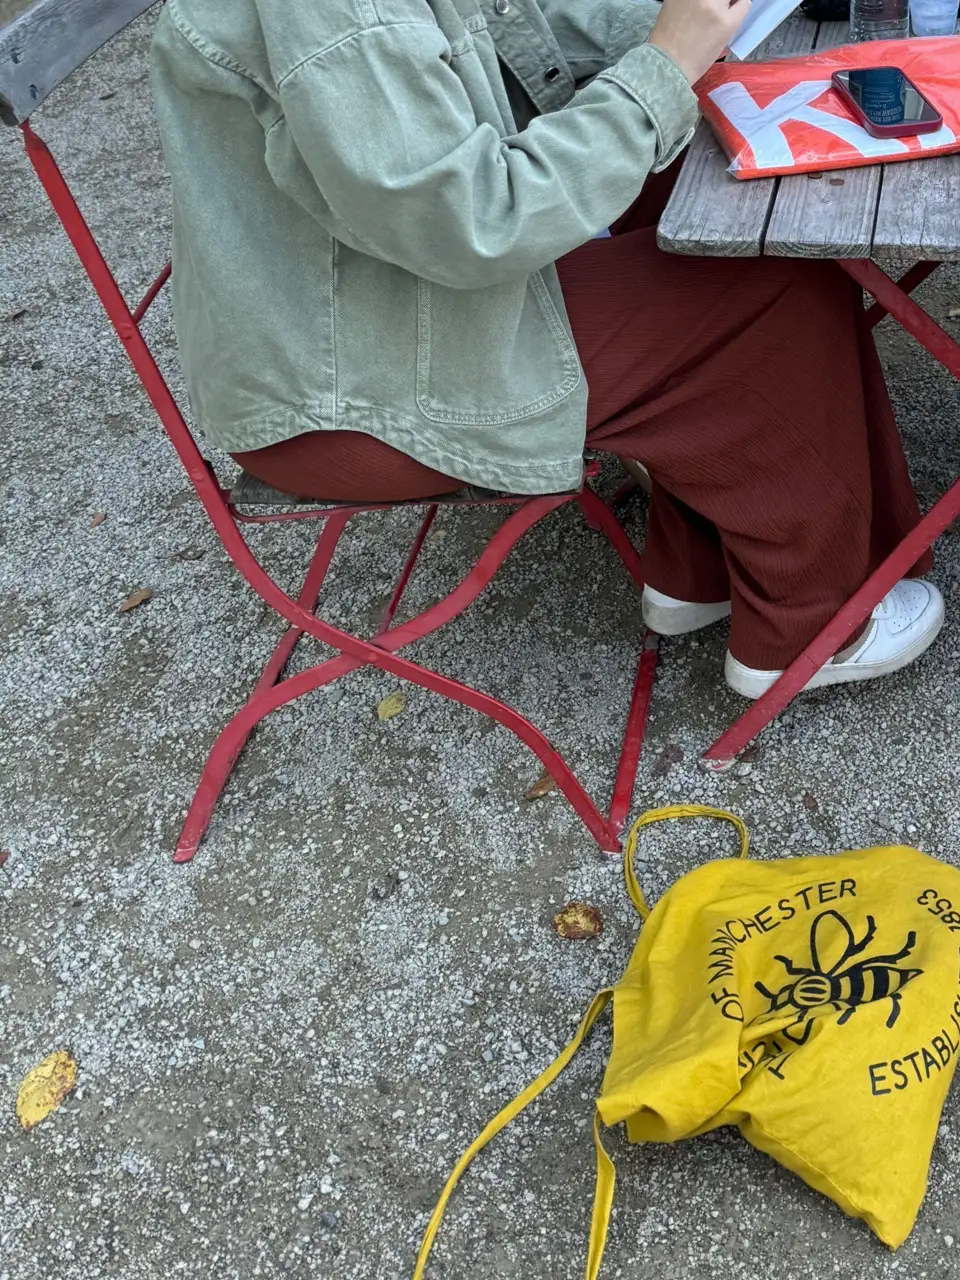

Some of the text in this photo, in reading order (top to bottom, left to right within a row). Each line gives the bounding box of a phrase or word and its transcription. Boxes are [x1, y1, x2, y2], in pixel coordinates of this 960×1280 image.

[707, 80, 957, 169] K
[708, 877, 857, 985] MANCHESTER
[710, 987, 745, 1023] OF
